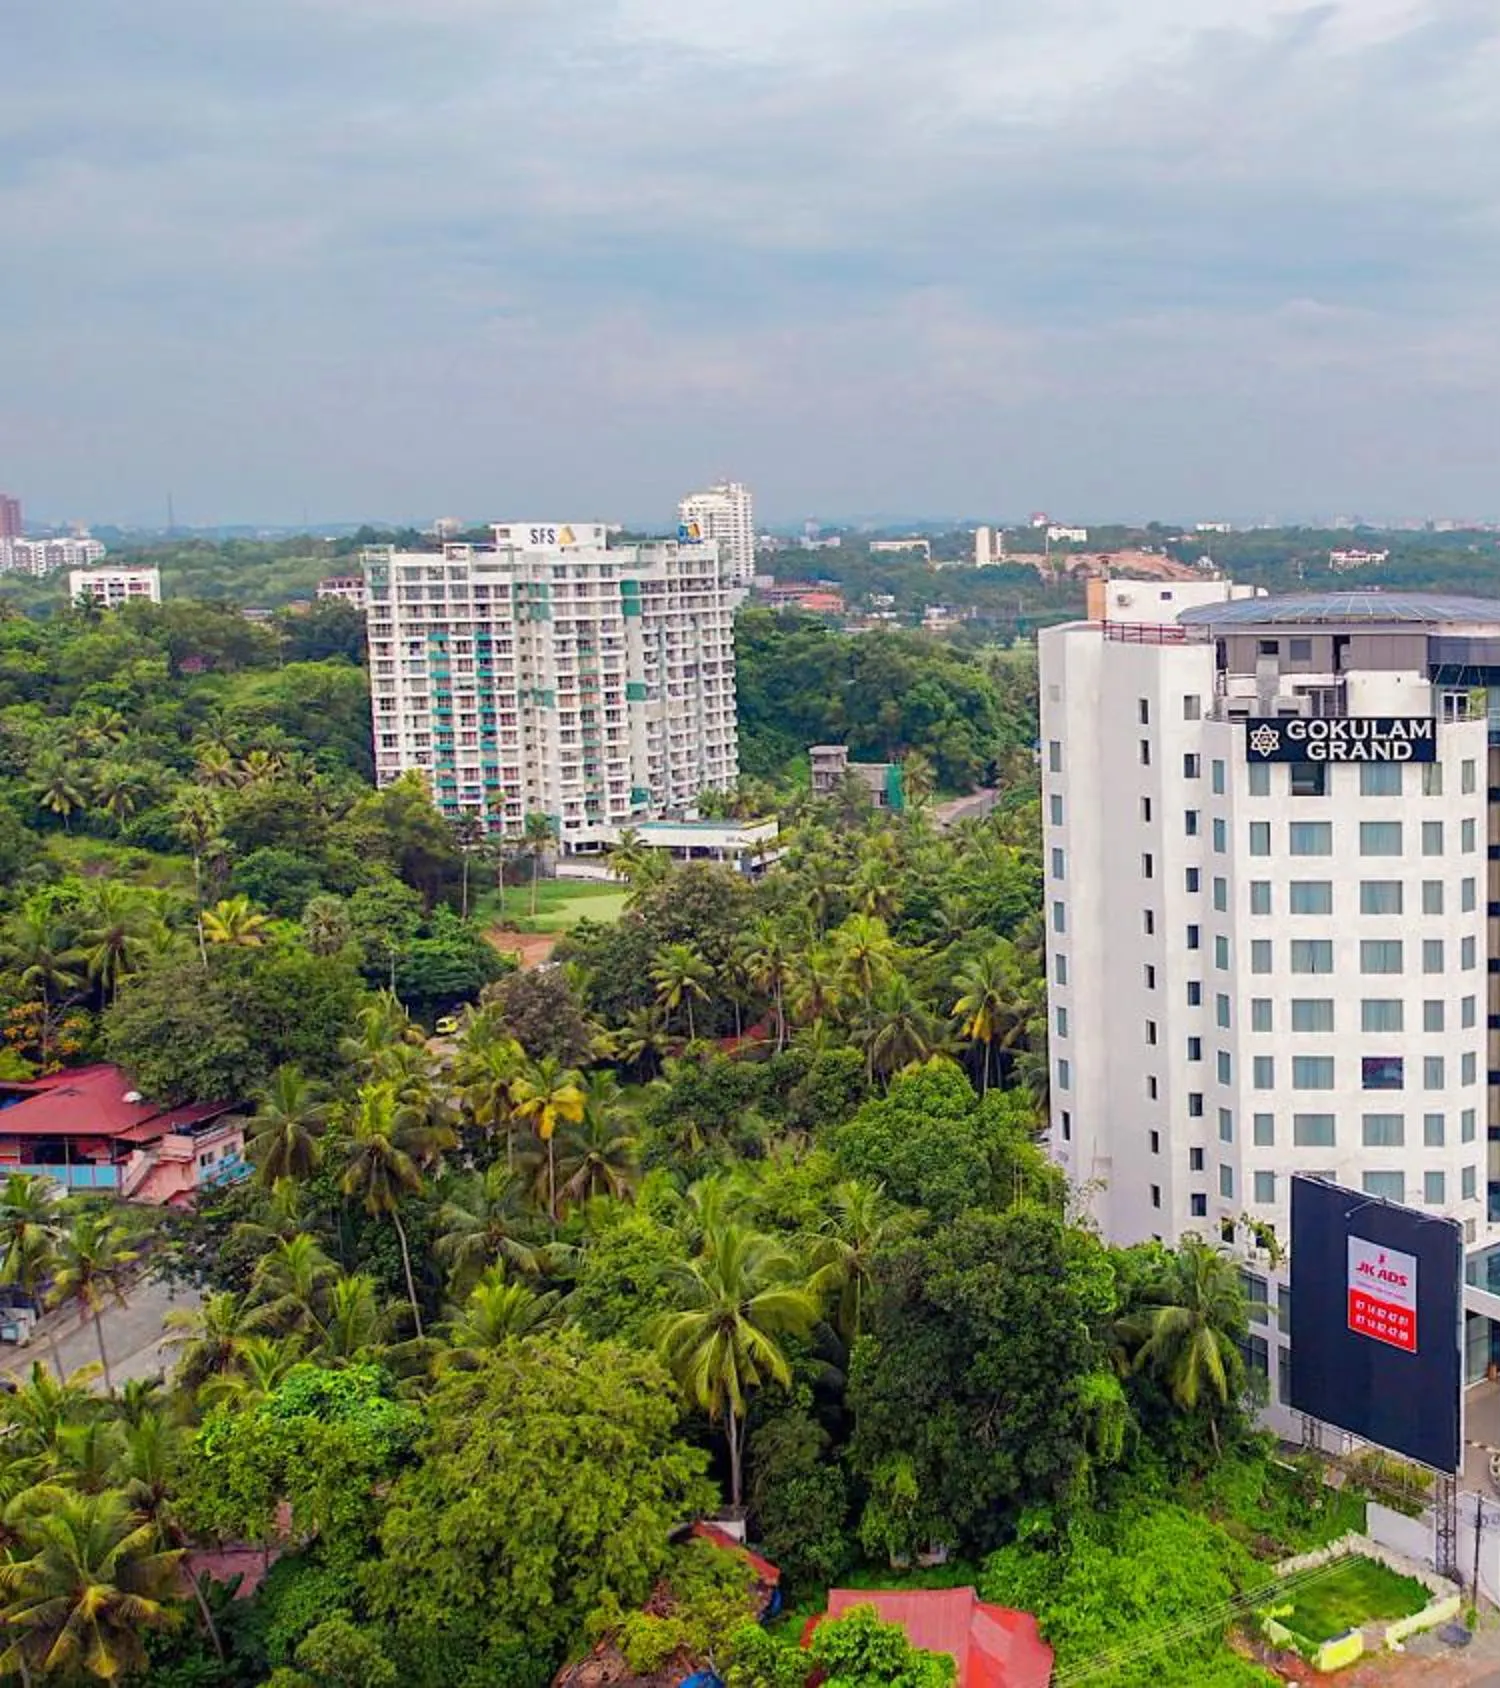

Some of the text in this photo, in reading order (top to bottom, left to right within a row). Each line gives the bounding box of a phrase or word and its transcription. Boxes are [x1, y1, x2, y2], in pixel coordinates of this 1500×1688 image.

[530, 528, 555, 545] SFS
[1286, 719, 1432, 740] GOKULAM
[1306, 741, 1413, 761] GRAND
[1356, 1261, 1408, 1287] JK ADS
